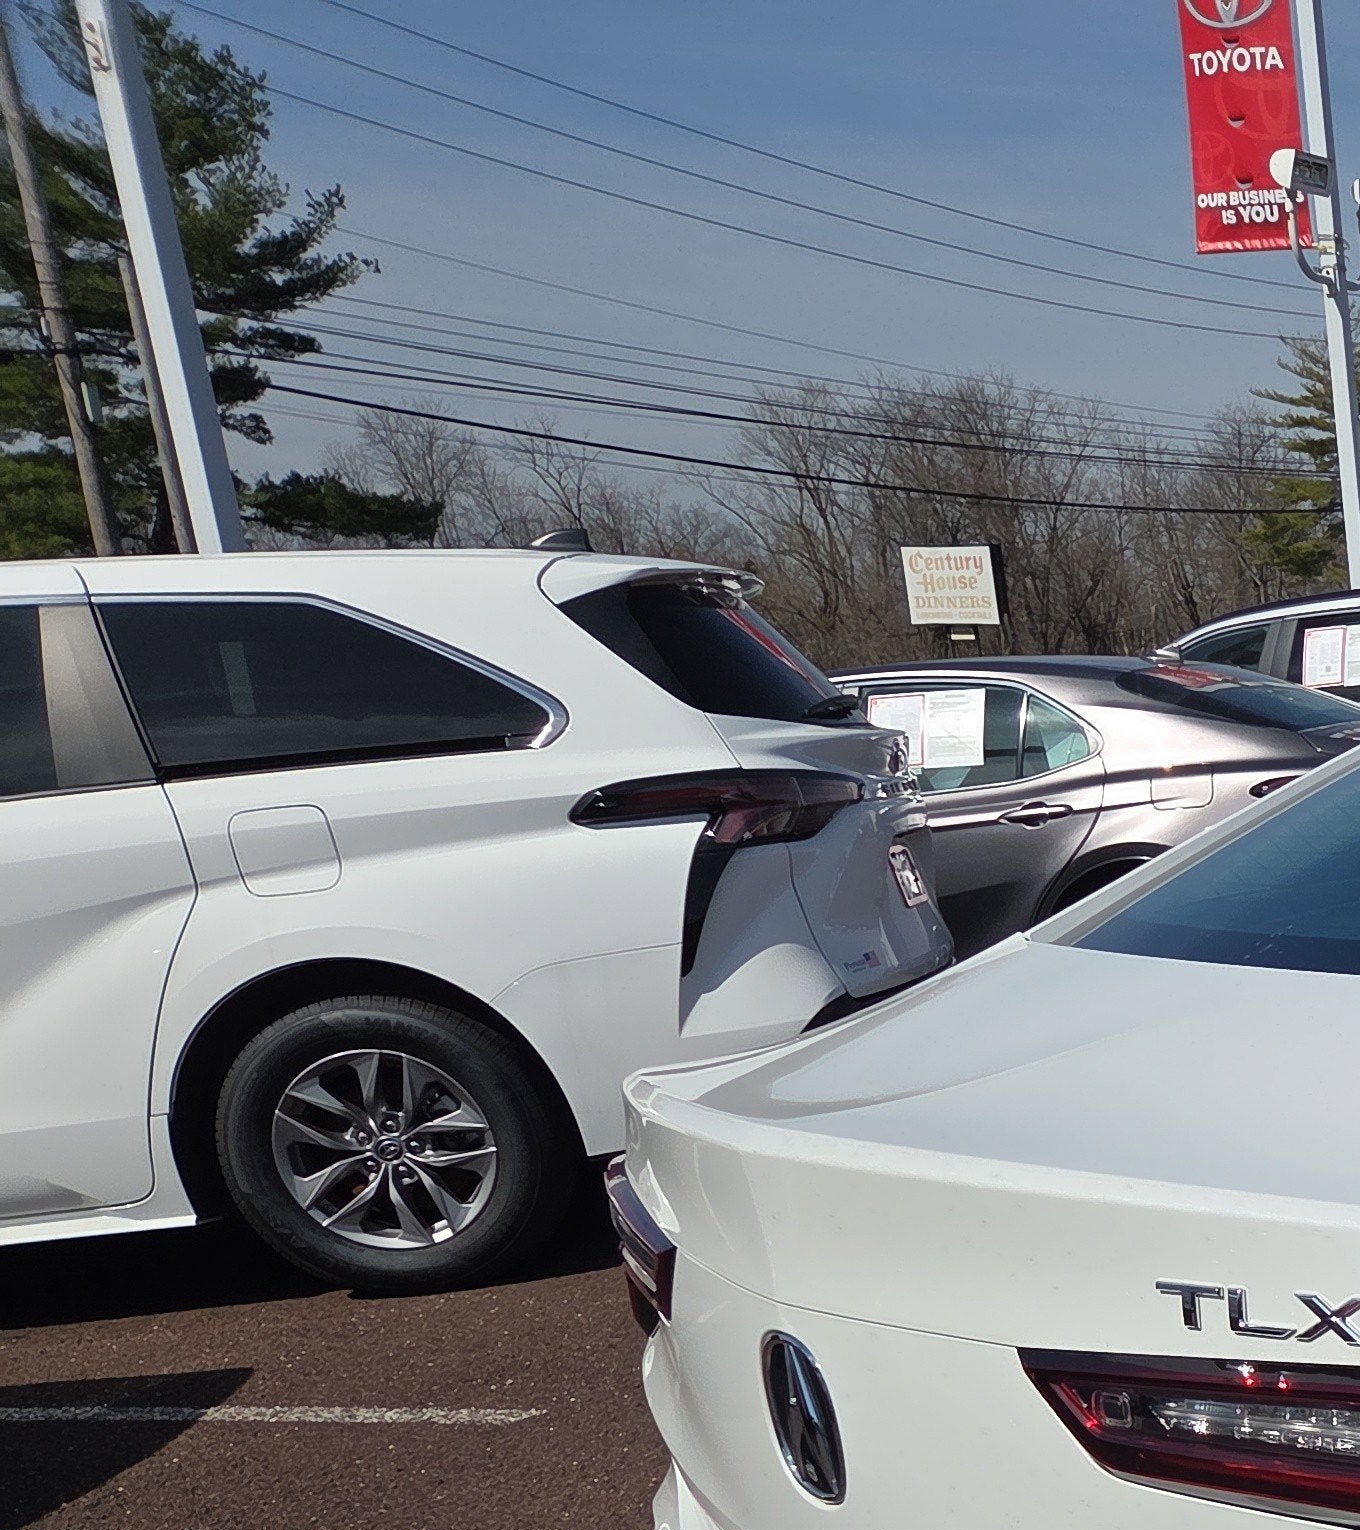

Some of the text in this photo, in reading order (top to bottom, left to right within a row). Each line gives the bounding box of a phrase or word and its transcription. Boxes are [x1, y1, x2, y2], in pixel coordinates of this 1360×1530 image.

[1189, 47, 1284, 77] TOYOTA
[1198, 188, 1304, 208] OUR BUSINES
[1221, 205, 1279, 225] IS YOU
[908, 550, 984, 575] Century
[916, 573, 978, 593] House
[915, 596, 992, 608] DINNERS
